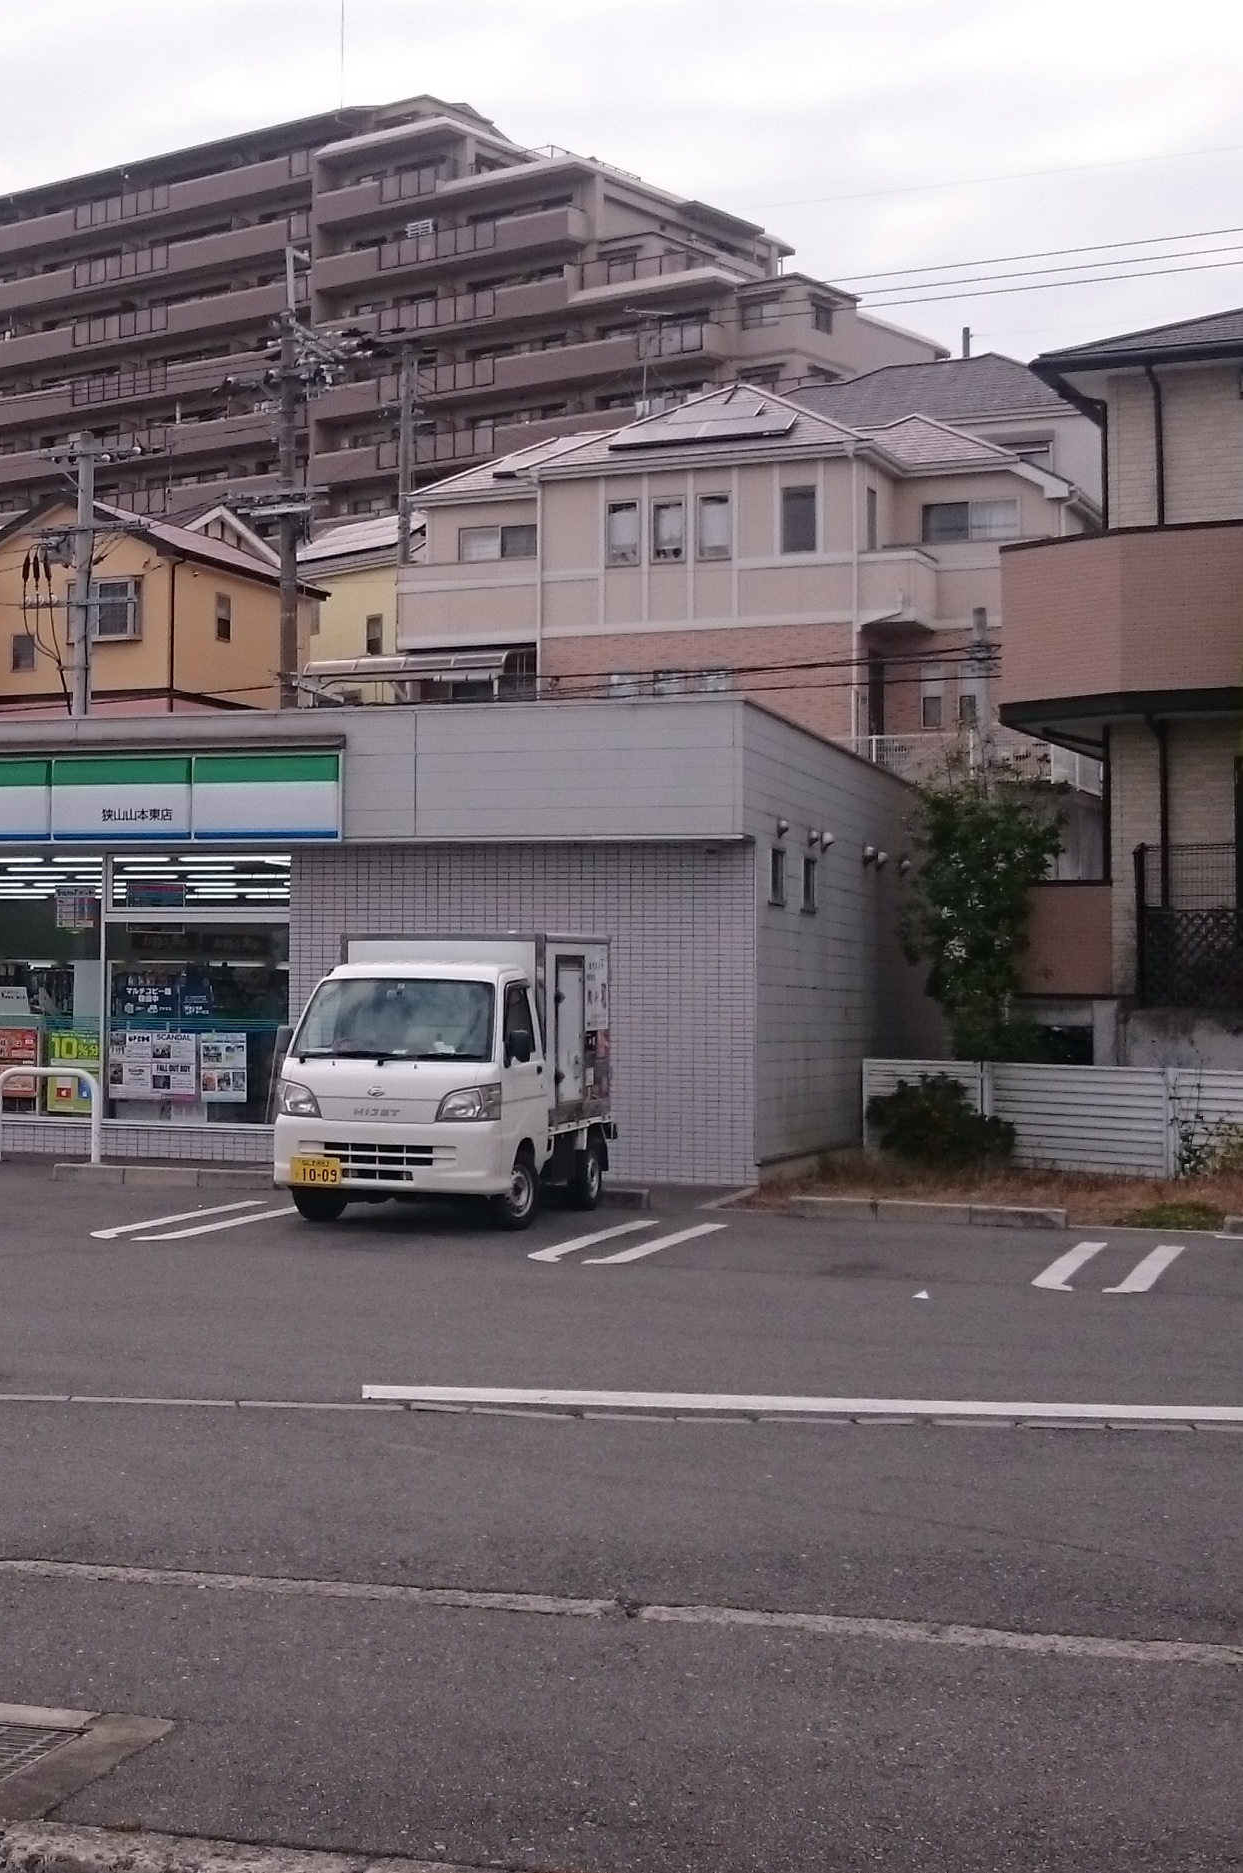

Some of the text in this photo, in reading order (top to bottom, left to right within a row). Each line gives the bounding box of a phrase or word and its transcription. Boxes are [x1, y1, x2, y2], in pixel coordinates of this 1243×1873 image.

[102, 808, 173, 822] 狭山山本東店
